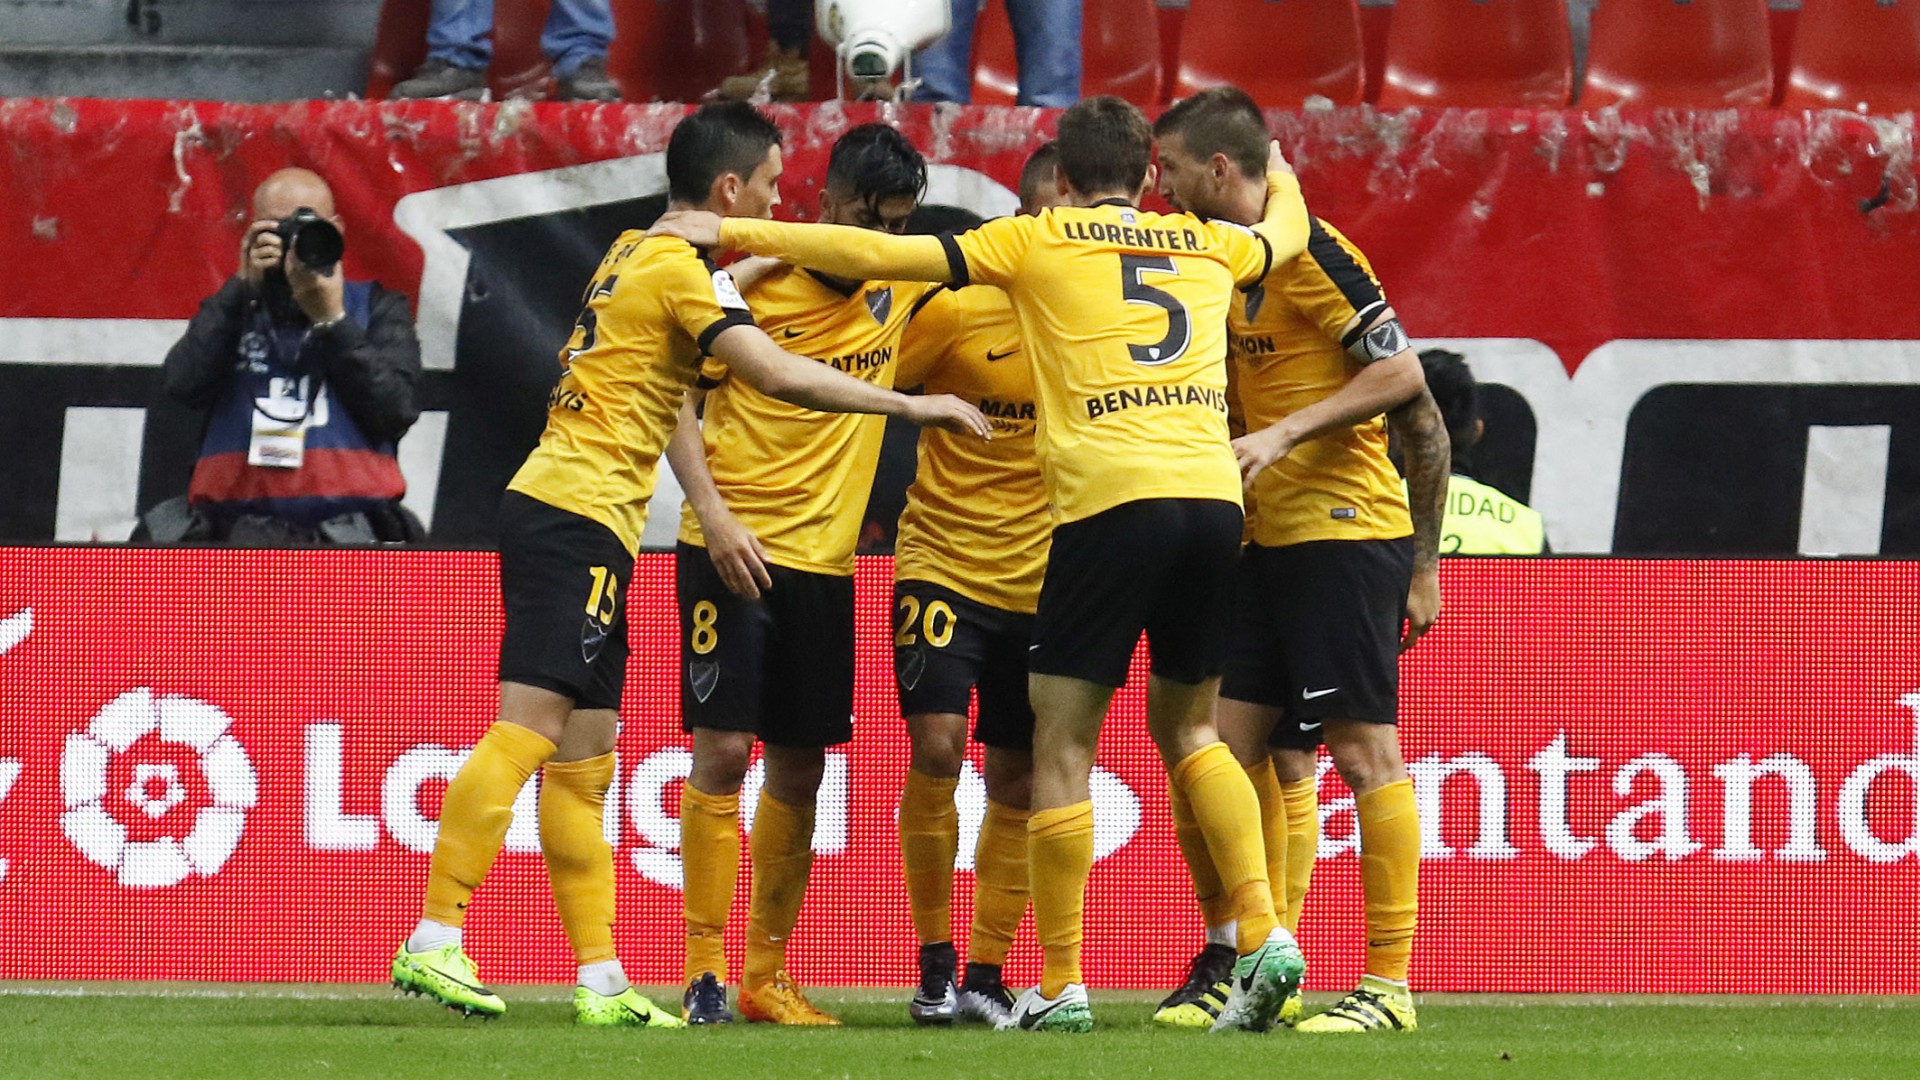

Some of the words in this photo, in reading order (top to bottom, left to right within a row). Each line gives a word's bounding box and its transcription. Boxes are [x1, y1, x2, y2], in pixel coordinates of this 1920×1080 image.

[1064, 222, 1181, 250] LLORENTE
[1119, 253, 1192, 366] 5
[813, 346, 892, 372] ATHON
[1087, 386, 1226, 419] BENAHAVIS
[1449, 491, 1515, 523] IDAD
[585, 566, 617, 625] 15
[895, 595, 957, 648] 20
[692, 600, 717, 654] 8
[1315, 692, 1920, 864] antand
